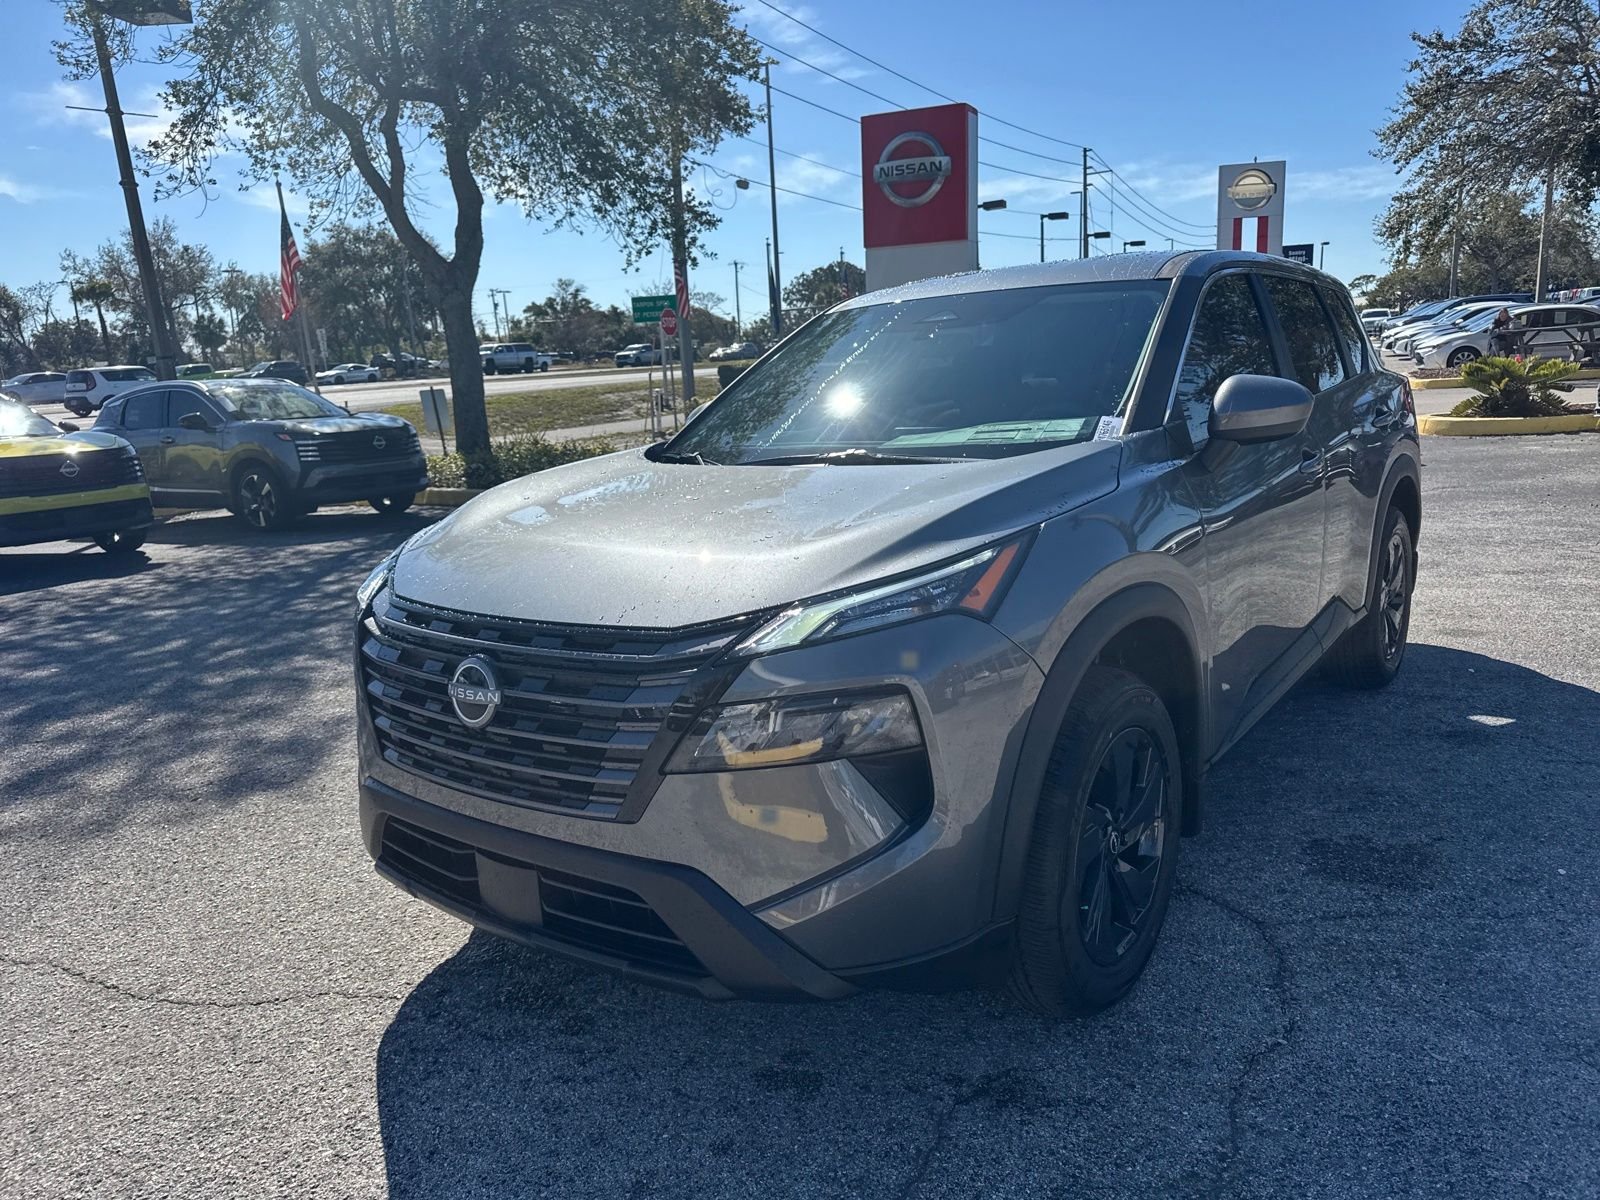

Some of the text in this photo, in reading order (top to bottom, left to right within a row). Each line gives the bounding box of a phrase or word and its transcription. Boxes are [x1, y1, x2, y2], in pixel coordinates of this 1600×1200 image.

[879, 160, 943, 178] NISSAN
[662, 316, 676, 328] STOP
[450, 685, 498, 702] NISSAN
